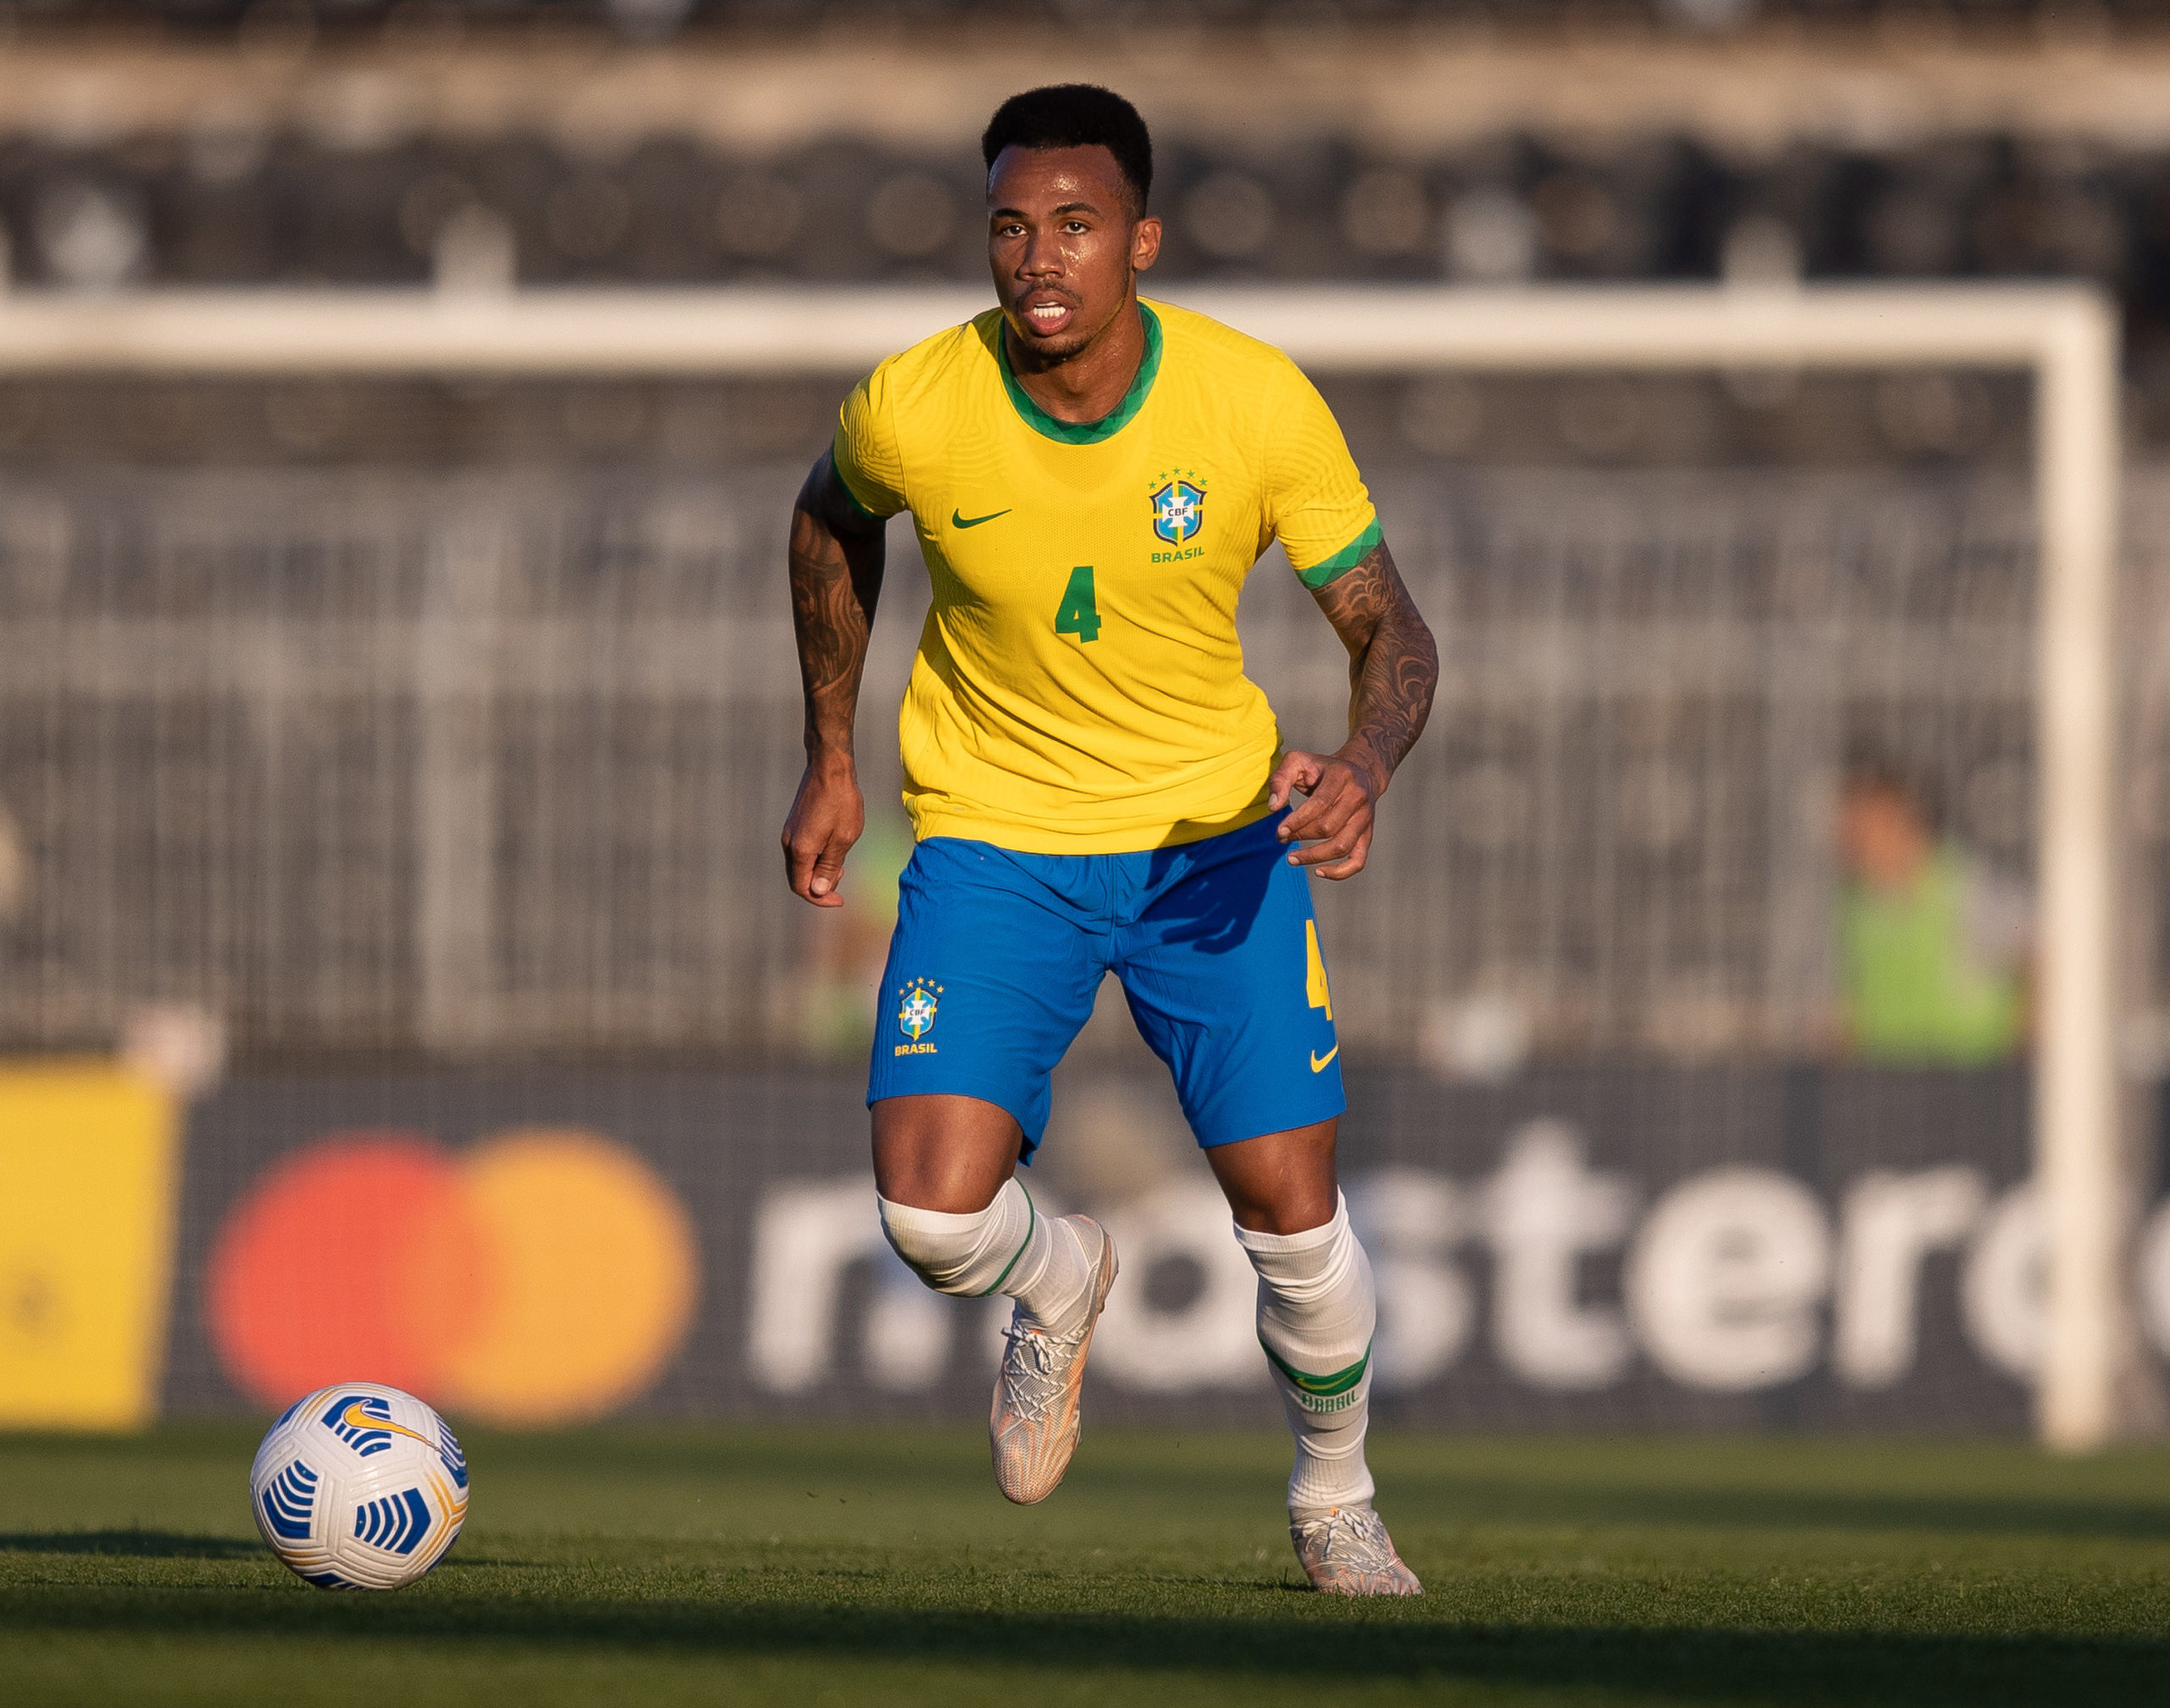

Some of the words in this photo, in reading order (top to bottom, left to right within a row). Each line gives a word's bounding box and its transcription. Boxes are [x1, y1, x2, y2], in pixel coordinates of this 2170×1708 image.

[1168, 507, 1188, 517] CBF
[1151, 546, 1205, 563] BRASIL
[1054, 565, 1101, 643] 4
[1305, 919, 1333, 1021] 4
[894, 1043, 938, 1057] BRASIL
